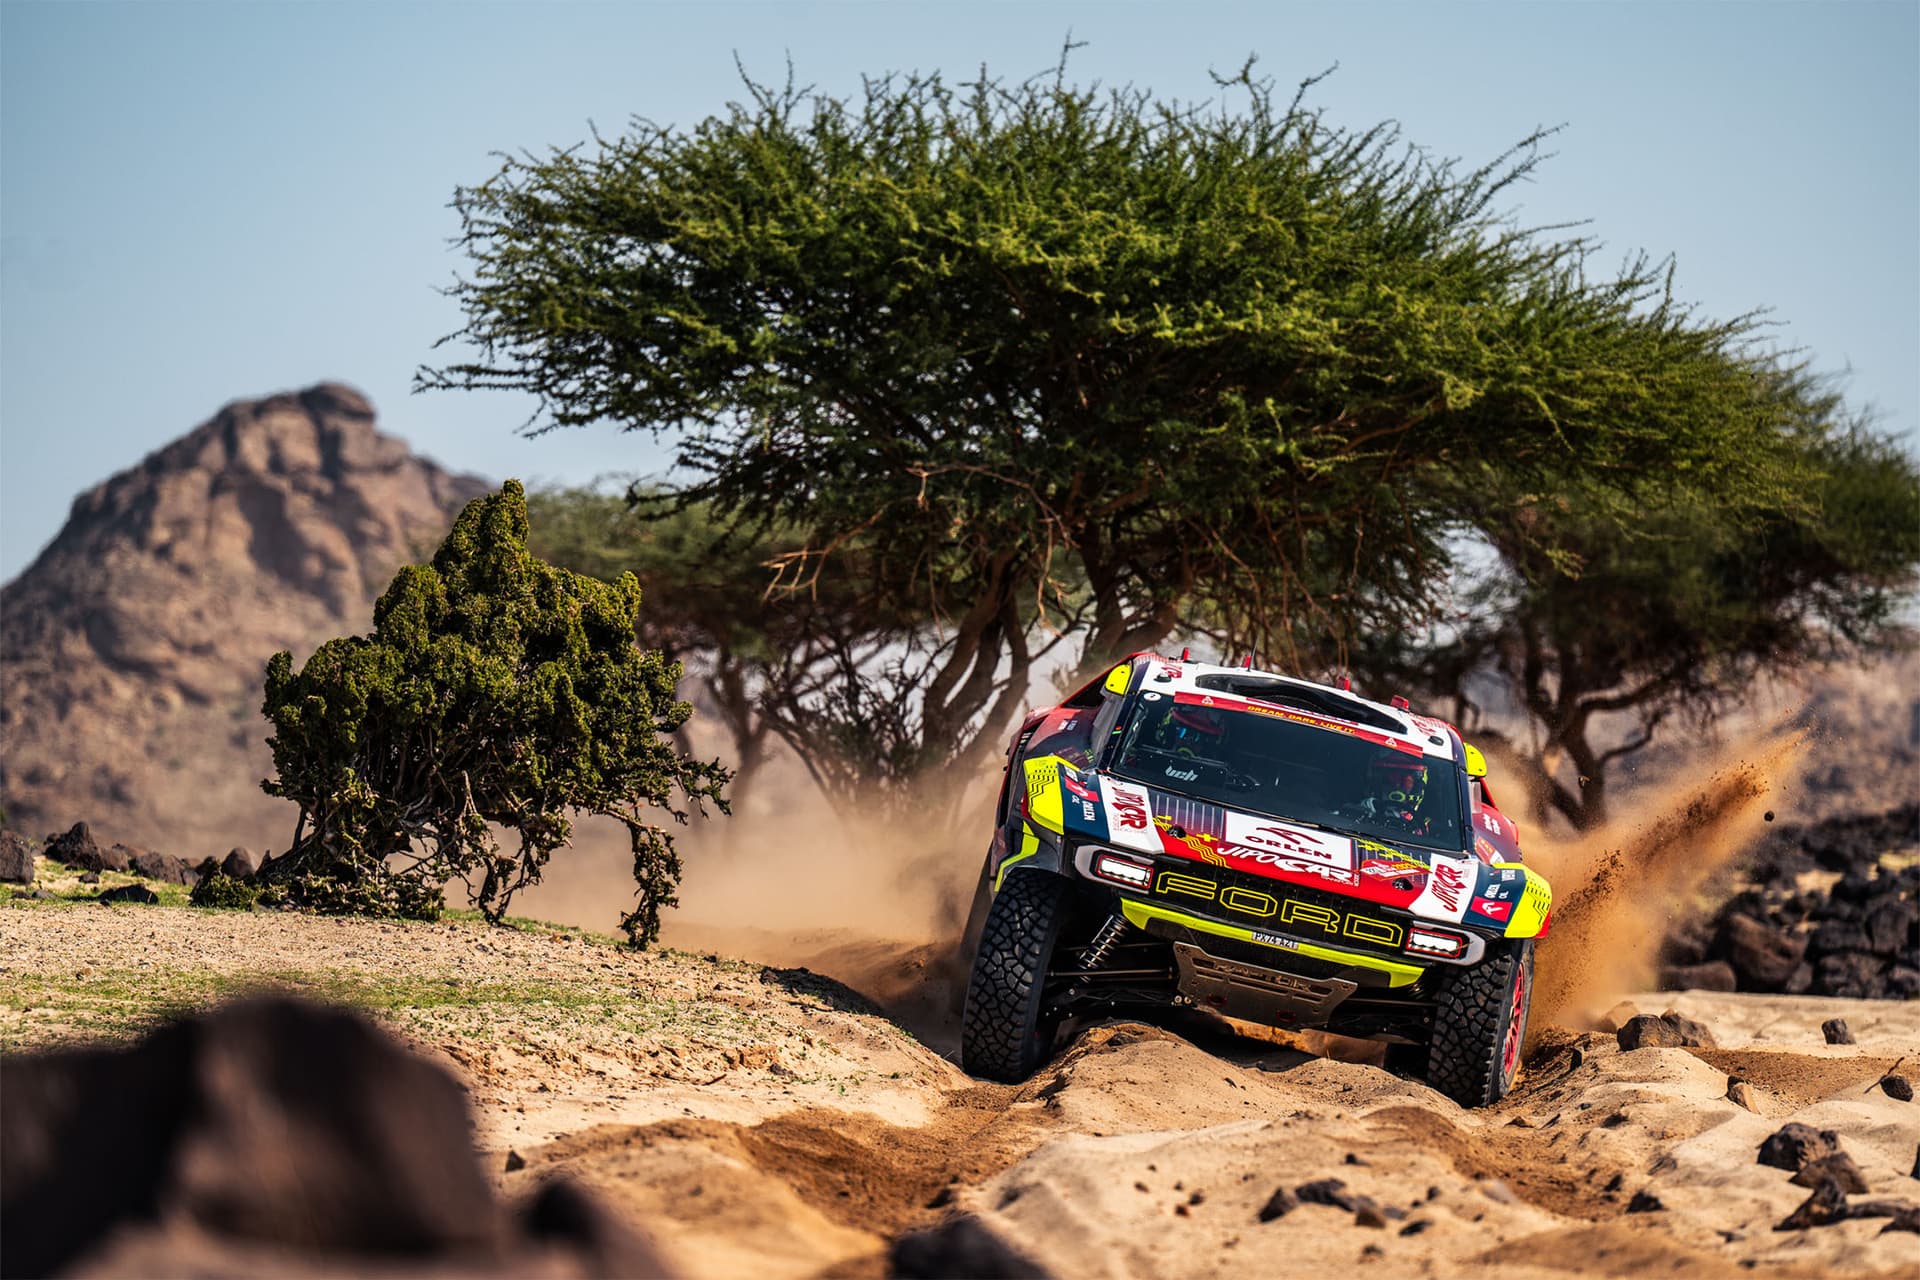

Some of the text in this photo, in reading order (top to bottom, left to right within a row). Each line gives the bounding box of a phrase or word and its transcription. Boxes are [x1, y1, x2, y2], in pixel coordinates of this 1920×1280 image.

[1217, 845, 1353, 882] JIPOCAR
[1245, 835, 1332, 860] ORLEN
[1156, 871, 1404, 947] FORD
